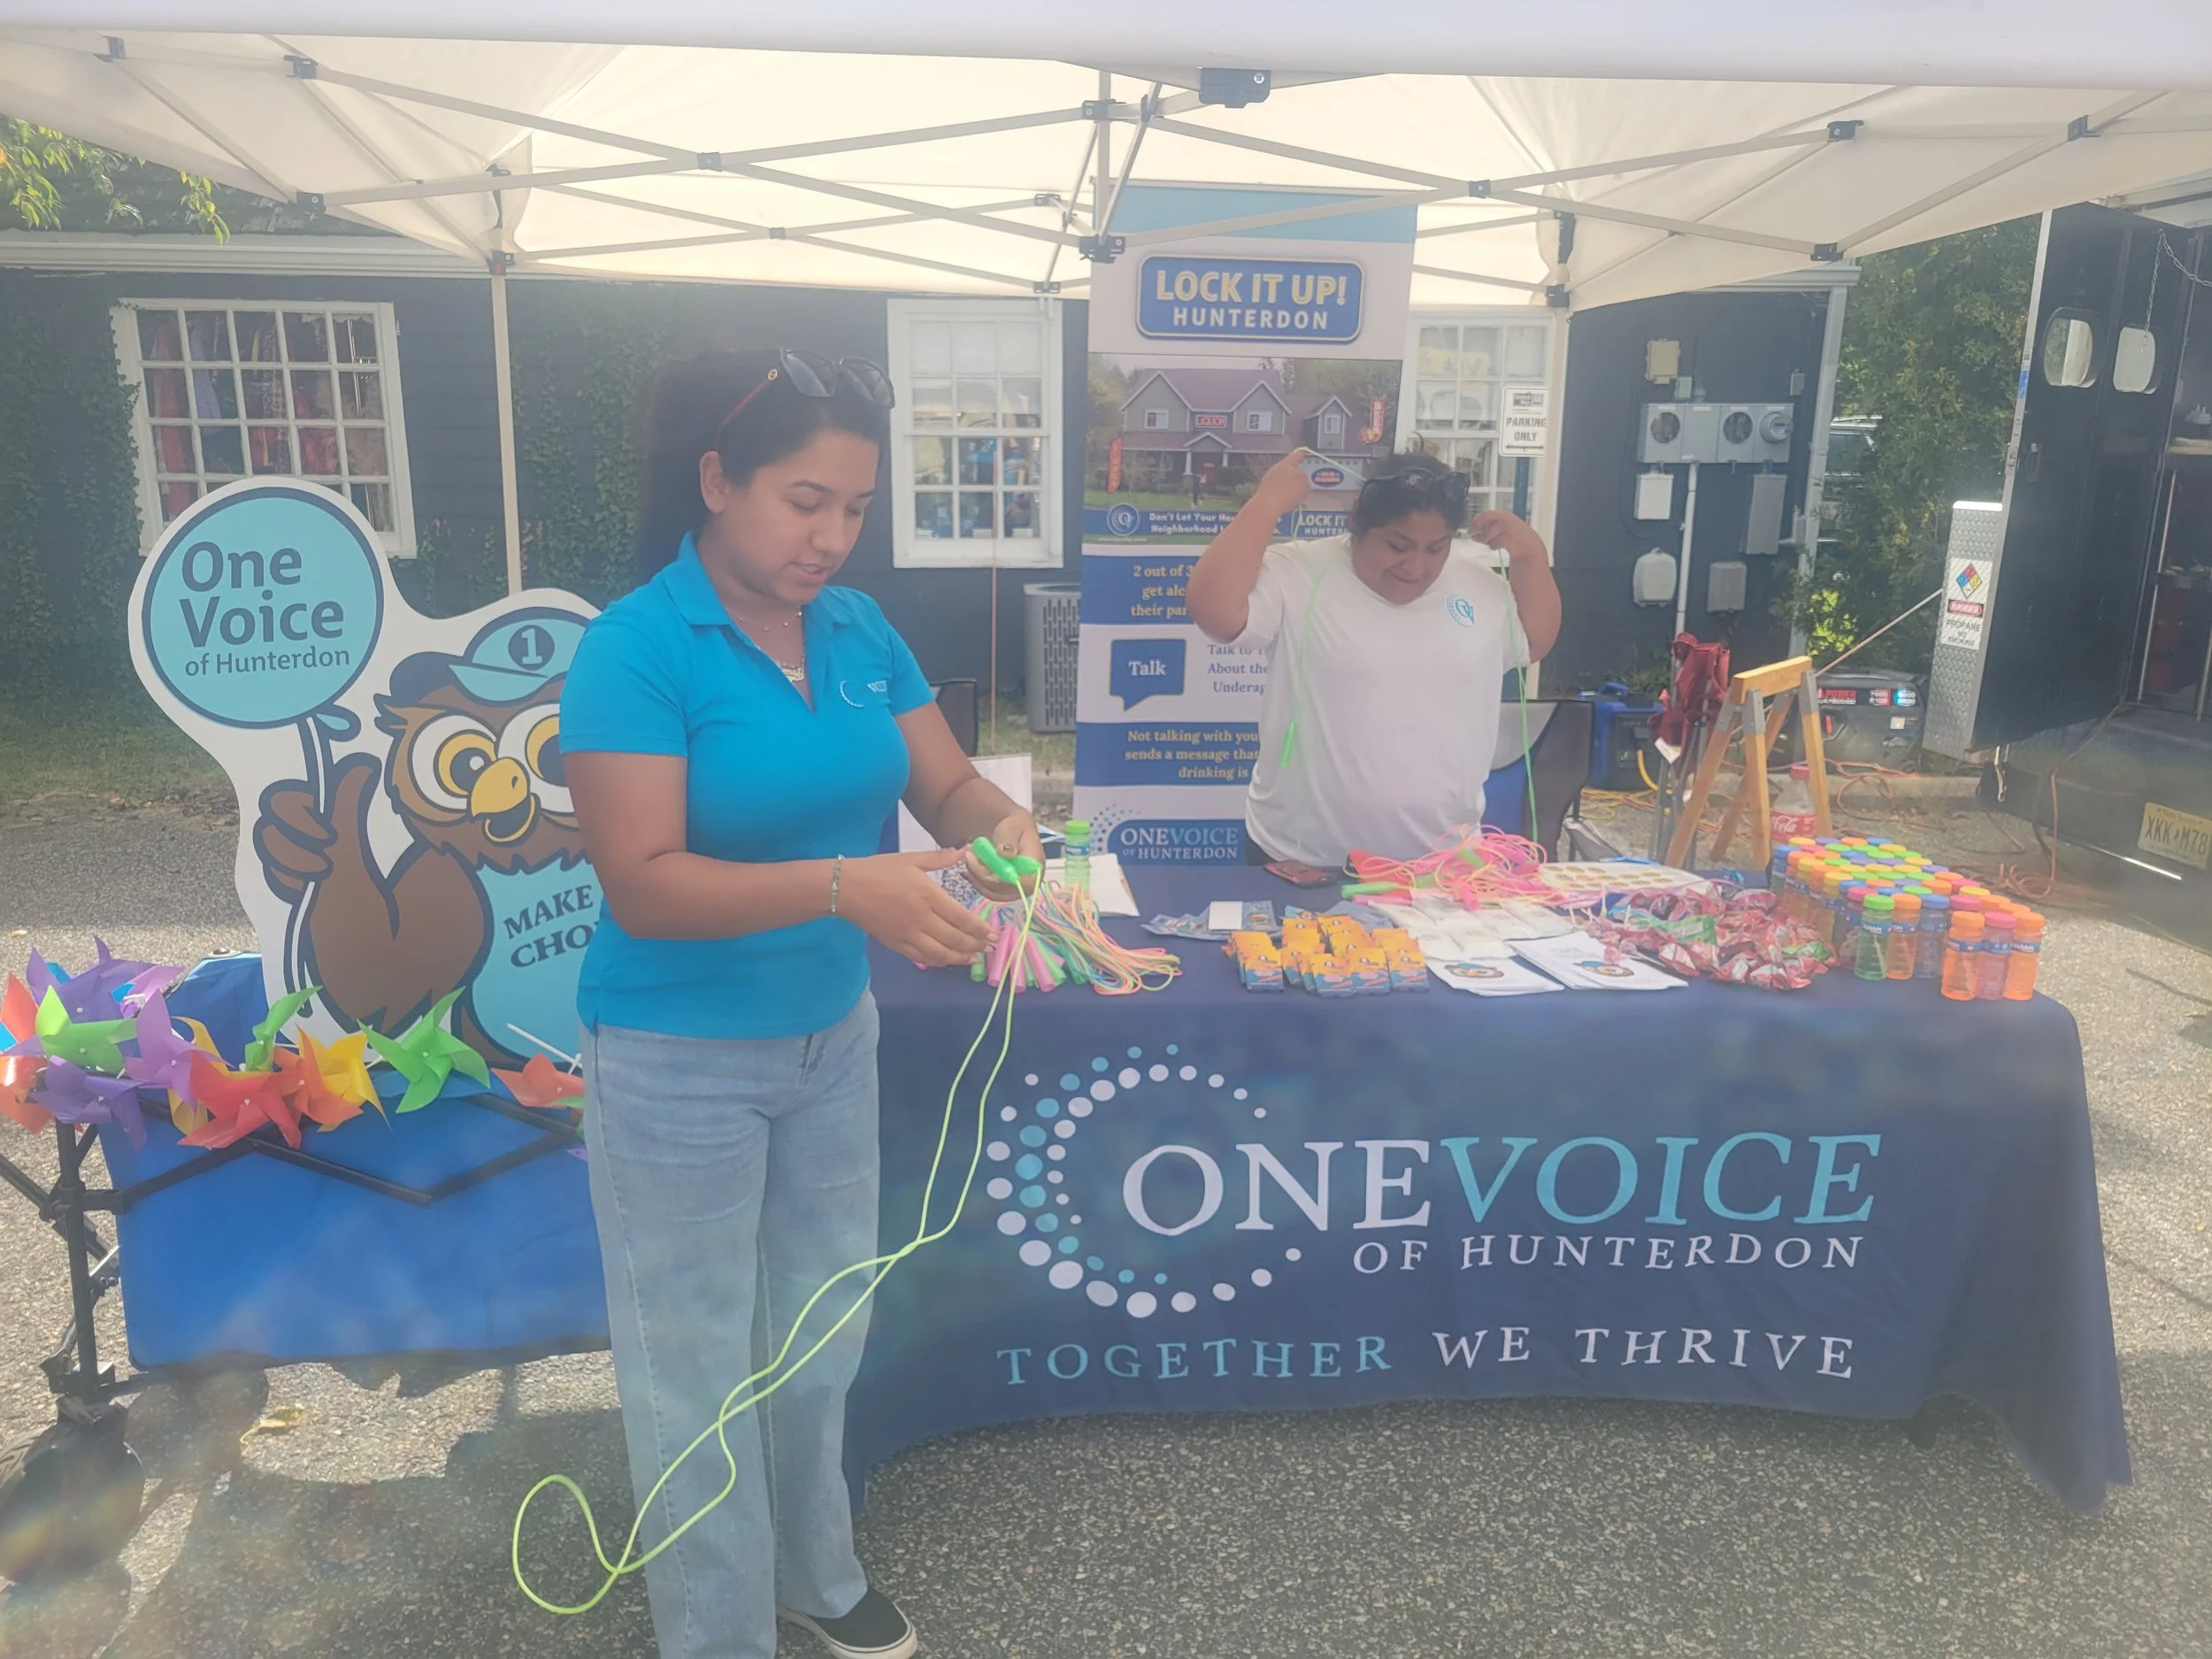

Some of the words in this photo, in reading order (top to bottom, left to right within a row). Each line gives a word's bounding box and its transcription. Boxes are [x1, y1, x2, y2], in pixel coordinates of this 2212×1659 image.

[1156, 270, 1243, 303] LOCK
[1251, 273, 1284, 303] IT
[1291, 274, 1347, 306] UP!
[1173, 306, 1328, 330] HUNTERDON
[1506, 418, 1548, 427] PARKING
[1514, 432, 1538, 442] ONLY
[1194, 513, 1217, 522] Your
[1299, 515, 1331, 526] LOCK
[1335, 516, 1346, 526] IT
[1151, 524, 1218, 534] Neighborhood
[181, 541, 303, 592] One
[1133, 565, 1142, 577] 2
[1144, 566, 1166, 577] out
[1170, 564, 1184, 577] of
[1141, 586, 1163, 600] get
[1131, 603, 1163, 616] their
[179, 590, 344, 649] Voice
[1947, 619, 1981, 633] PROPANE
[520, 629, 543, 665] 1
[185, 654, 209, 677] of
[216, 645, 350, 674] Hunterdon
[1128, 660, 1167, 676] Talk
[1207, 664, 1245, 674] About
[1213, 681, 1265, 695] Underag
[1128, 730, 1150, 741] Not
[1154, 730, 1200, 744] talking
[1203, 730, 1232, 741] with
[1125, 749, 1162, 760] sends
[1165, 750, 1172, 759] a
[1176, 750, 1230, 763] message
[1179, 765, 1234, 780] drinking
[1238, 766, 1248, 777] is
[2146, 815, 2173, 844] XKK
[1138, 847, 1238, 859] HUNTERDON
[503, 885, 594, 940] MAKE
[511, 921, 599, 967] CHO
[1353, 1240, 1427, 1274] OF
[1460, 1233, 1863, 1271] HUNTERDON
[996, 1336, 1392, 1386] TOGETHER
[1432, 1327, 1531, 1369] WE
[1574, 1328, 1854, 1379] THRIVE
